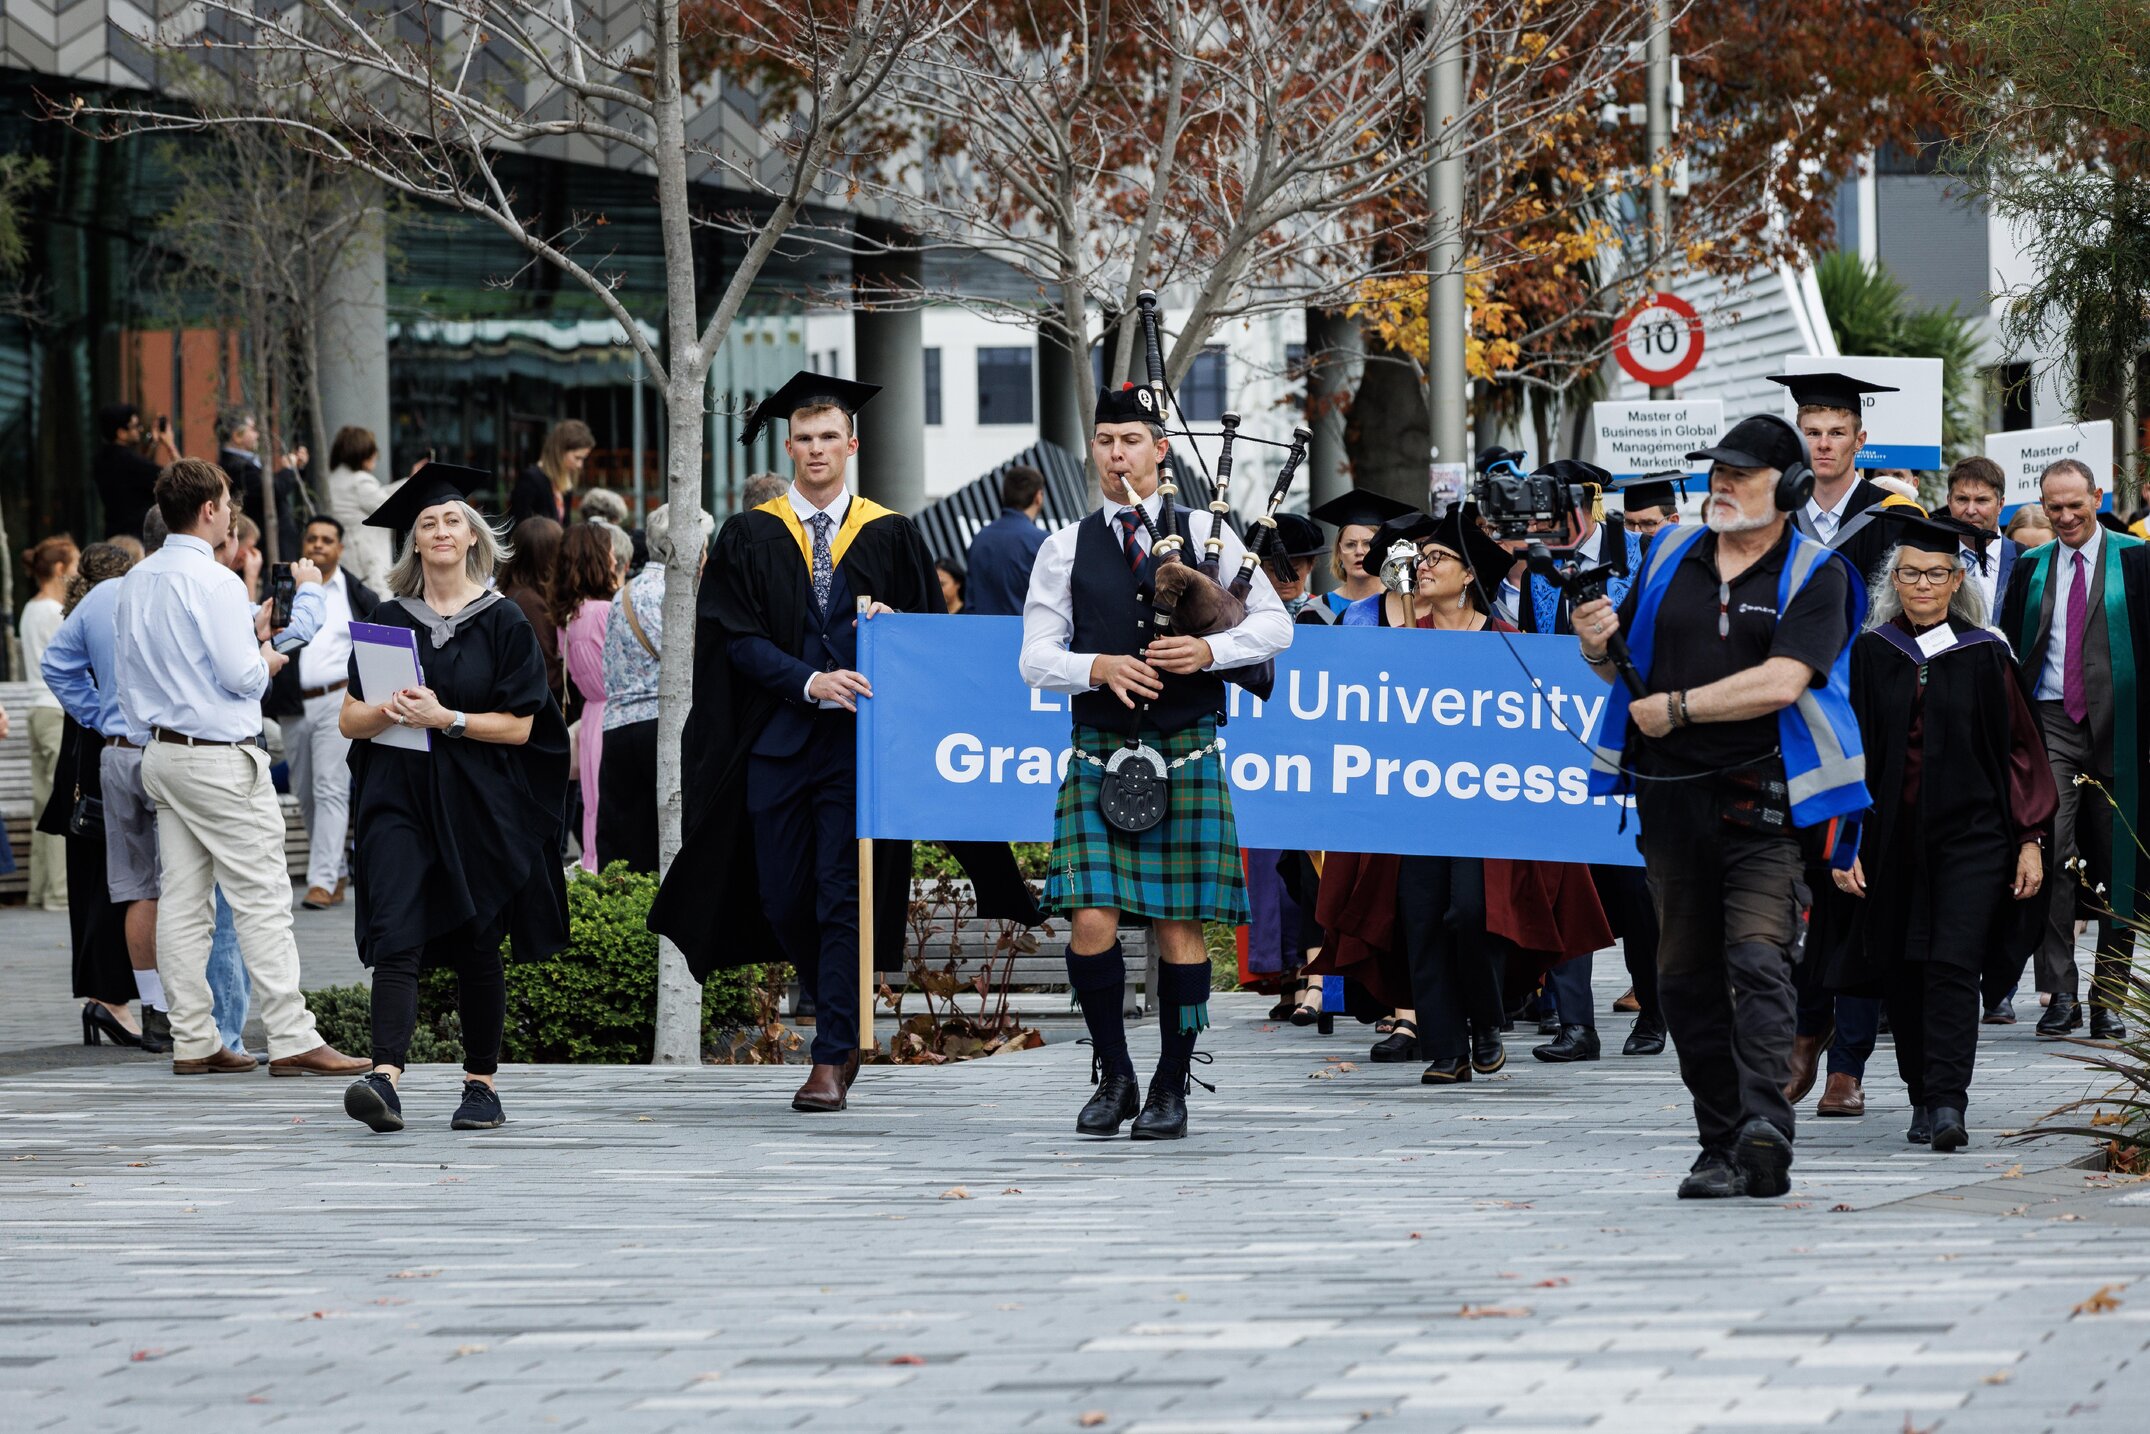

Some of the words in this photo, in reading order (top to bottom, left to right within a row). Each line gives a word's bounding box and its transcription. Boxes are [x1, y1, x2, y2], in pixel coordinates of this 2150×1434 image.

[1642, 323, 1678, 354] 10
[1628, 411, 1671, 421] Master
[1675, 410, 1687, 421] of
[1602, 427, 1657, 438] Business
[1661, 426, 1672, 436] in
[1676, 424, 1717, 436] Global
[1612, 441, 1695, 455] Management
[1700, 441, 1708, 450] &
[2021, 446, 2063, 459] Master
[2067, 441, 2080, 454] of
[1630, 457, 1694, 469] Marketing
[2018, 478, 2030, 490] in
[1288, 669, 1605, 744] University
[935, 732, 1312, 793] Graon
[1332, 743, 1638, 809] Process
